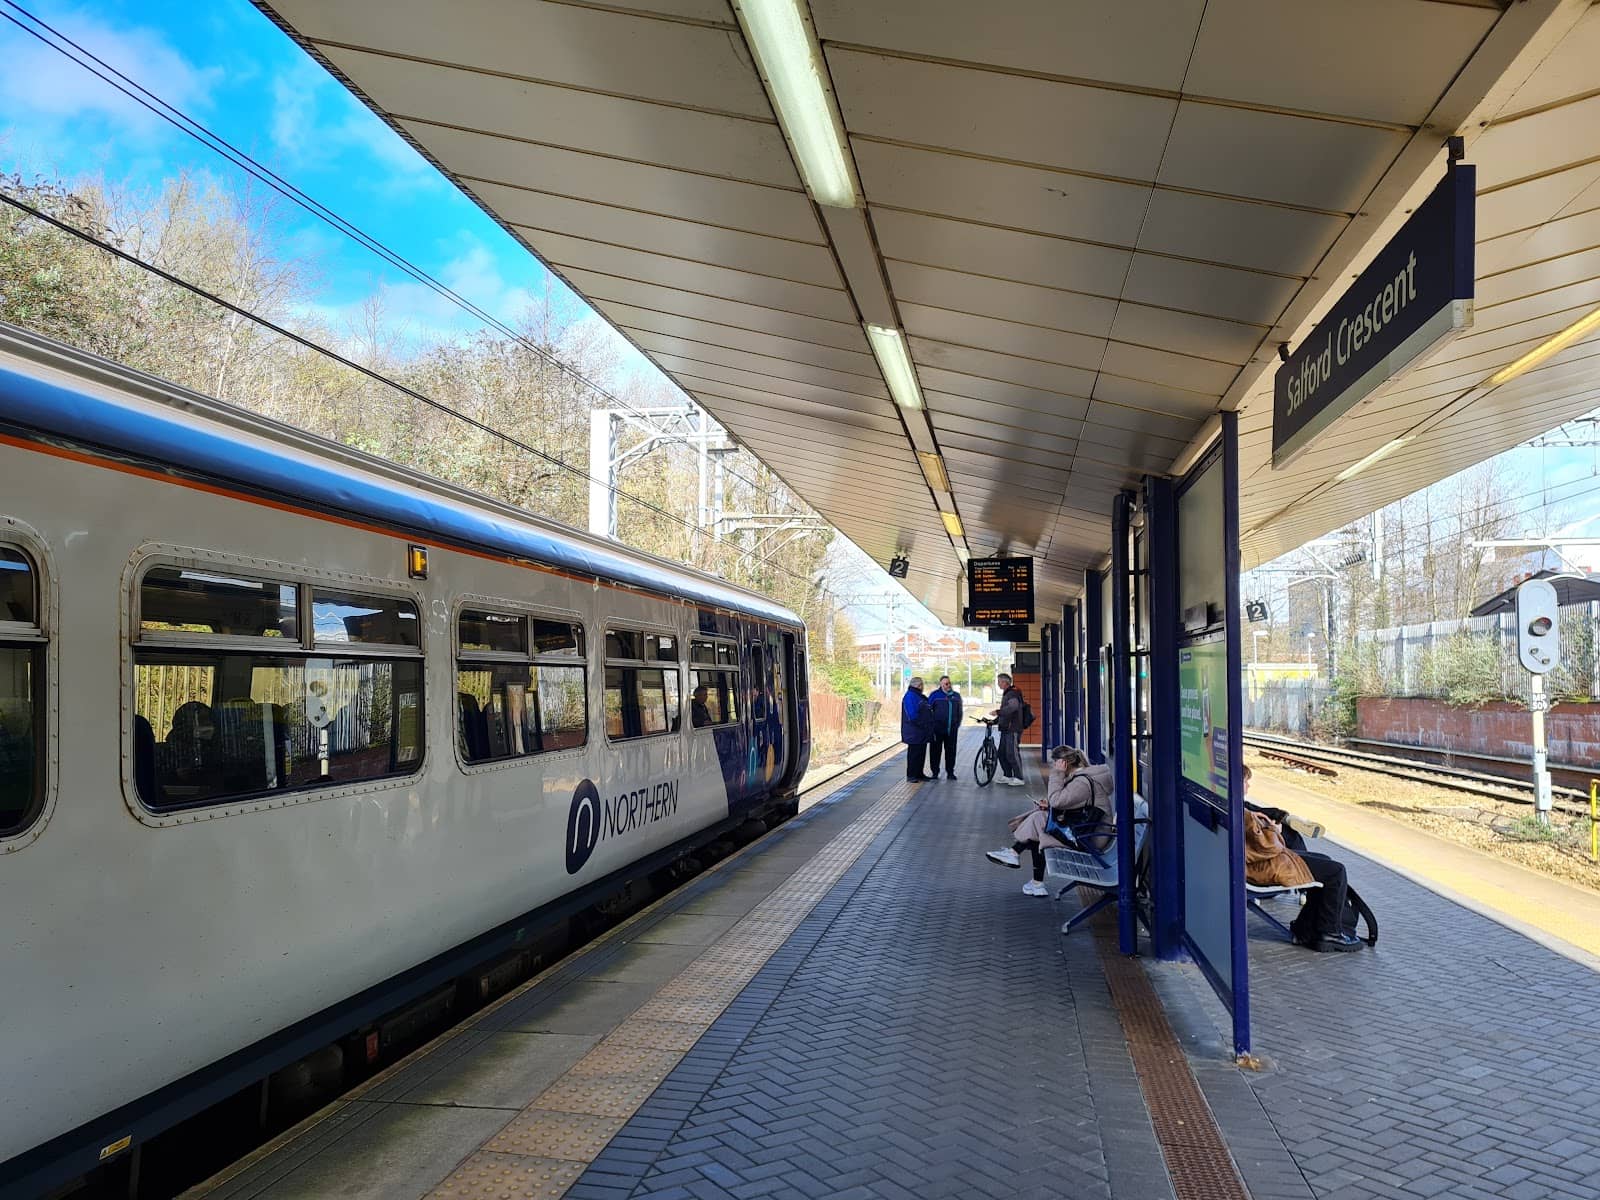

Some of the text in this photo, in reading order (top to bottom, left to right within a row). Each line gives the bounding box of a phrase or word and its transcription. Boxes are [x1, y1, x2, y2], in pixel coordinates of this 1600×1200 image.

[1287, 250, 1417, 416] Salford Crescent
[895, 561, 904, 574] 2
[1252, 605, 1263, 617] 2
[602, 779, 679, 841] NORTHERN
